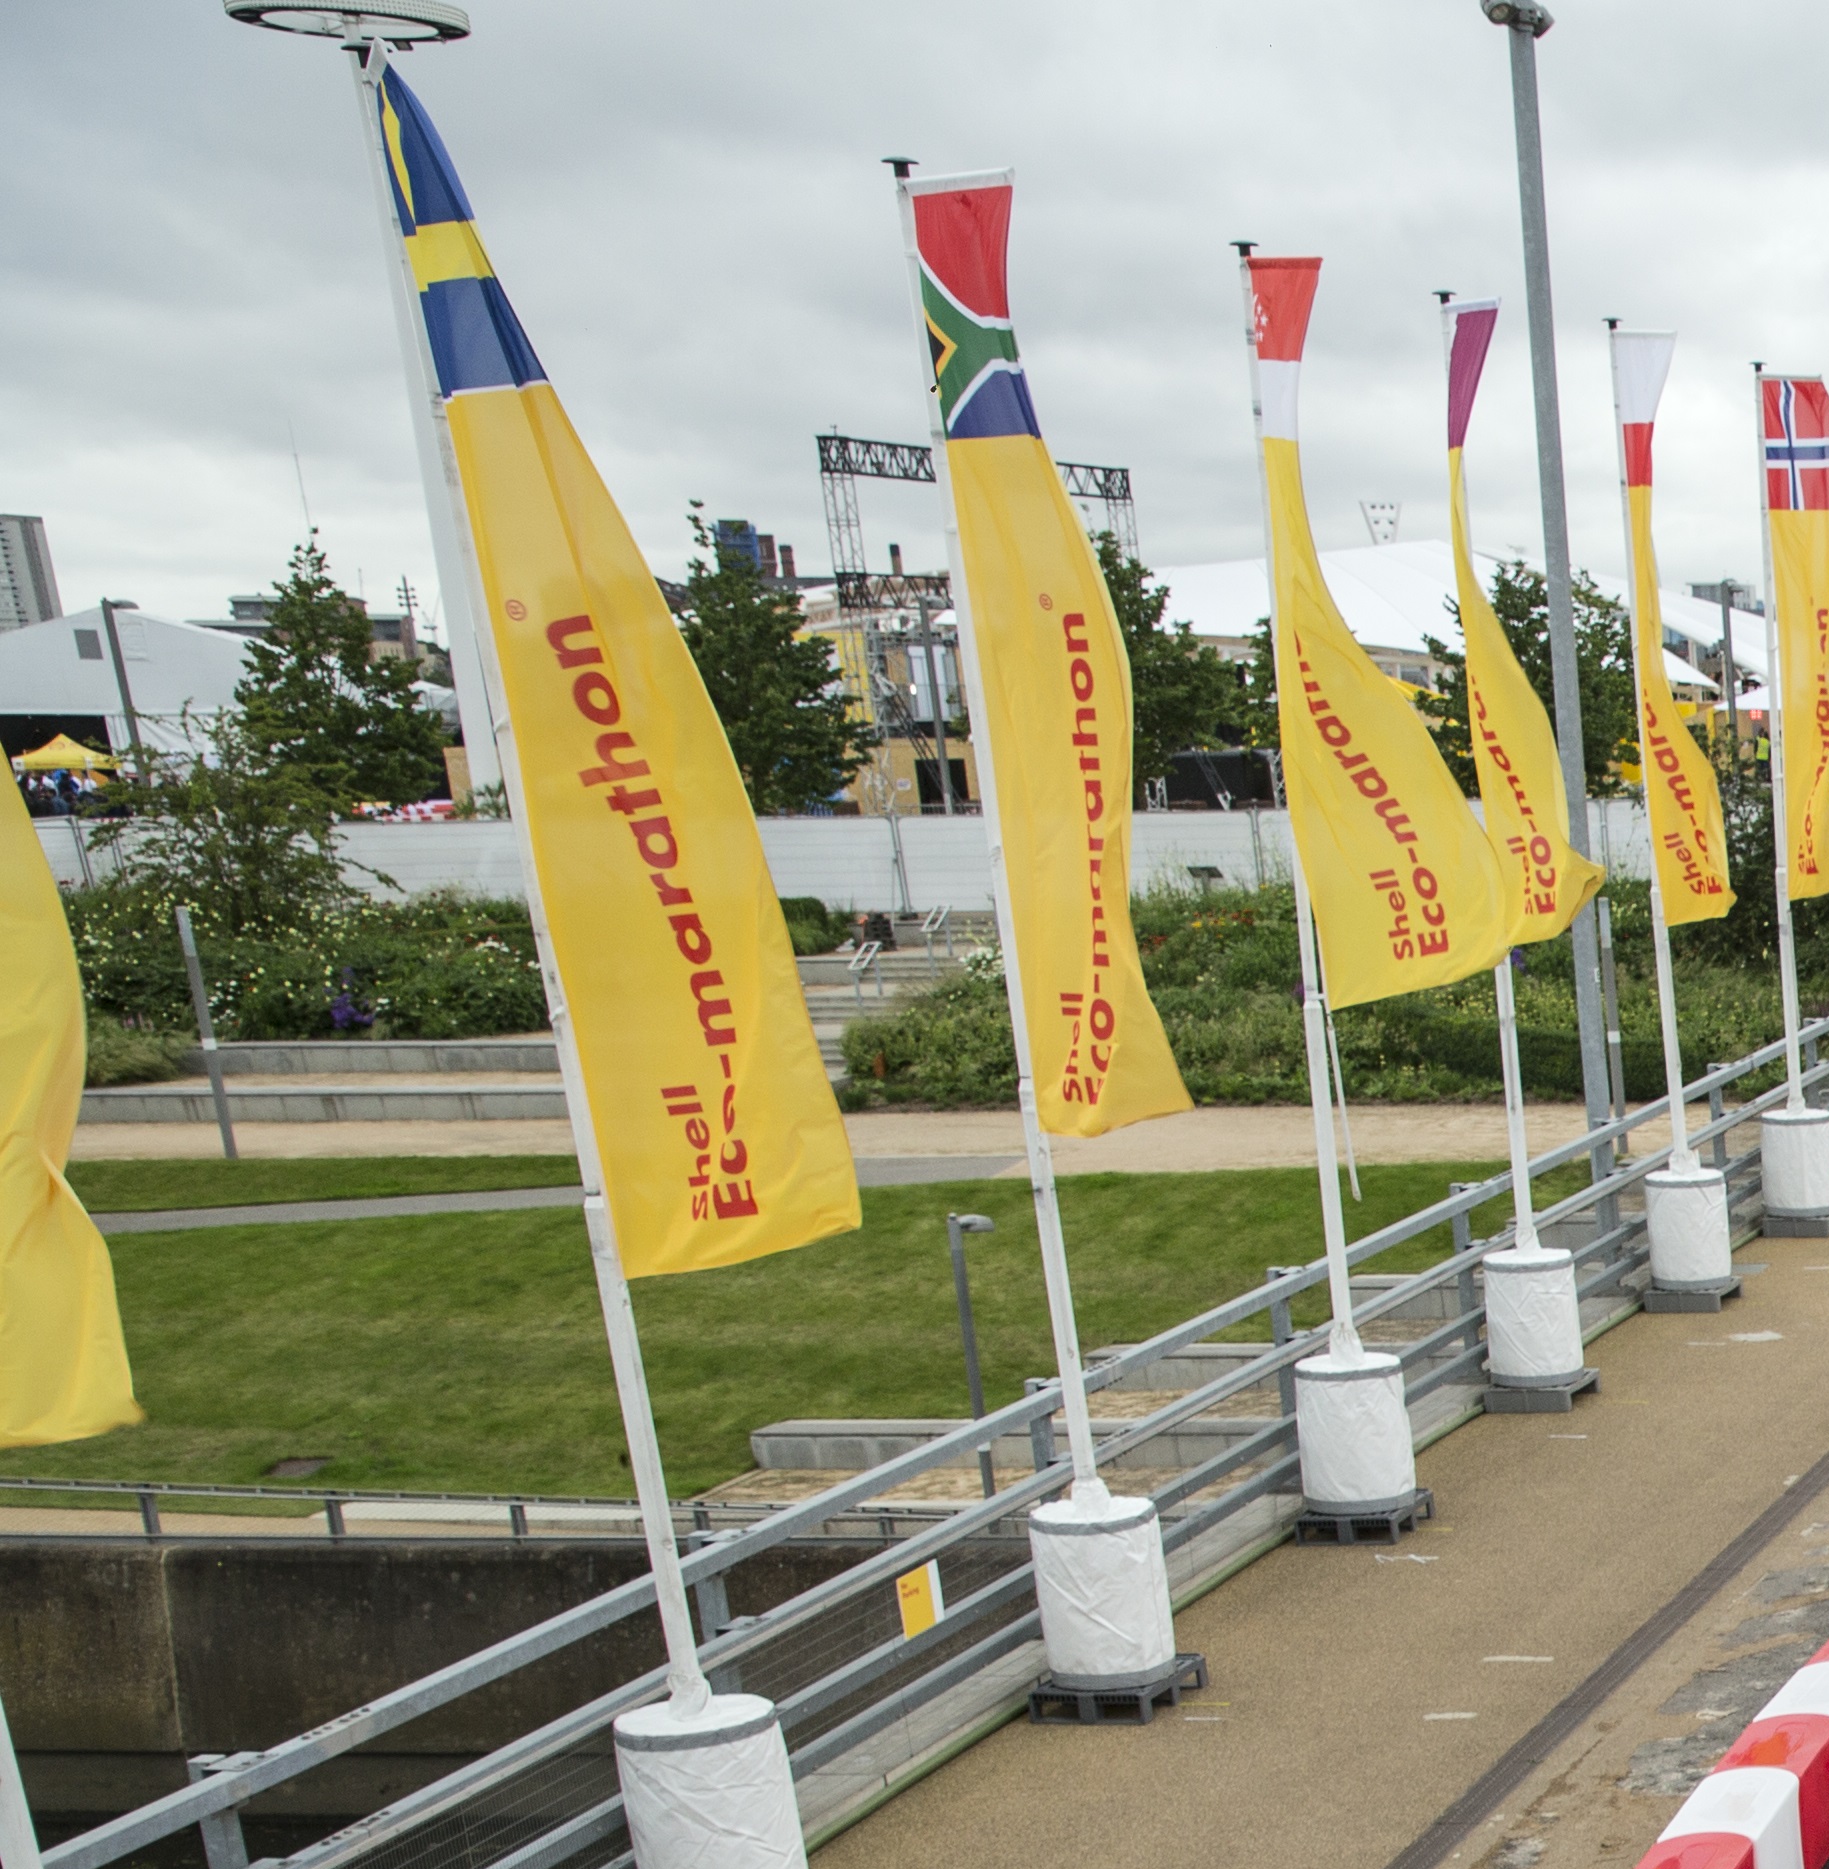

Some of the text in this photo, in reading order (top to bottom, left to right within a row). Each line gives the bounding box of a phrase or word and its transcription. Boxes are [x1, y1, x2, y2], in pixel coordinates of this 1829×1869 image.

[1664, 833, 1706, 895] Shell
[1369, 869, 1414, 960] Shell
[1060, 993, 1084, 1103] Shell
[662, 1085, 708, 1222] Shell
